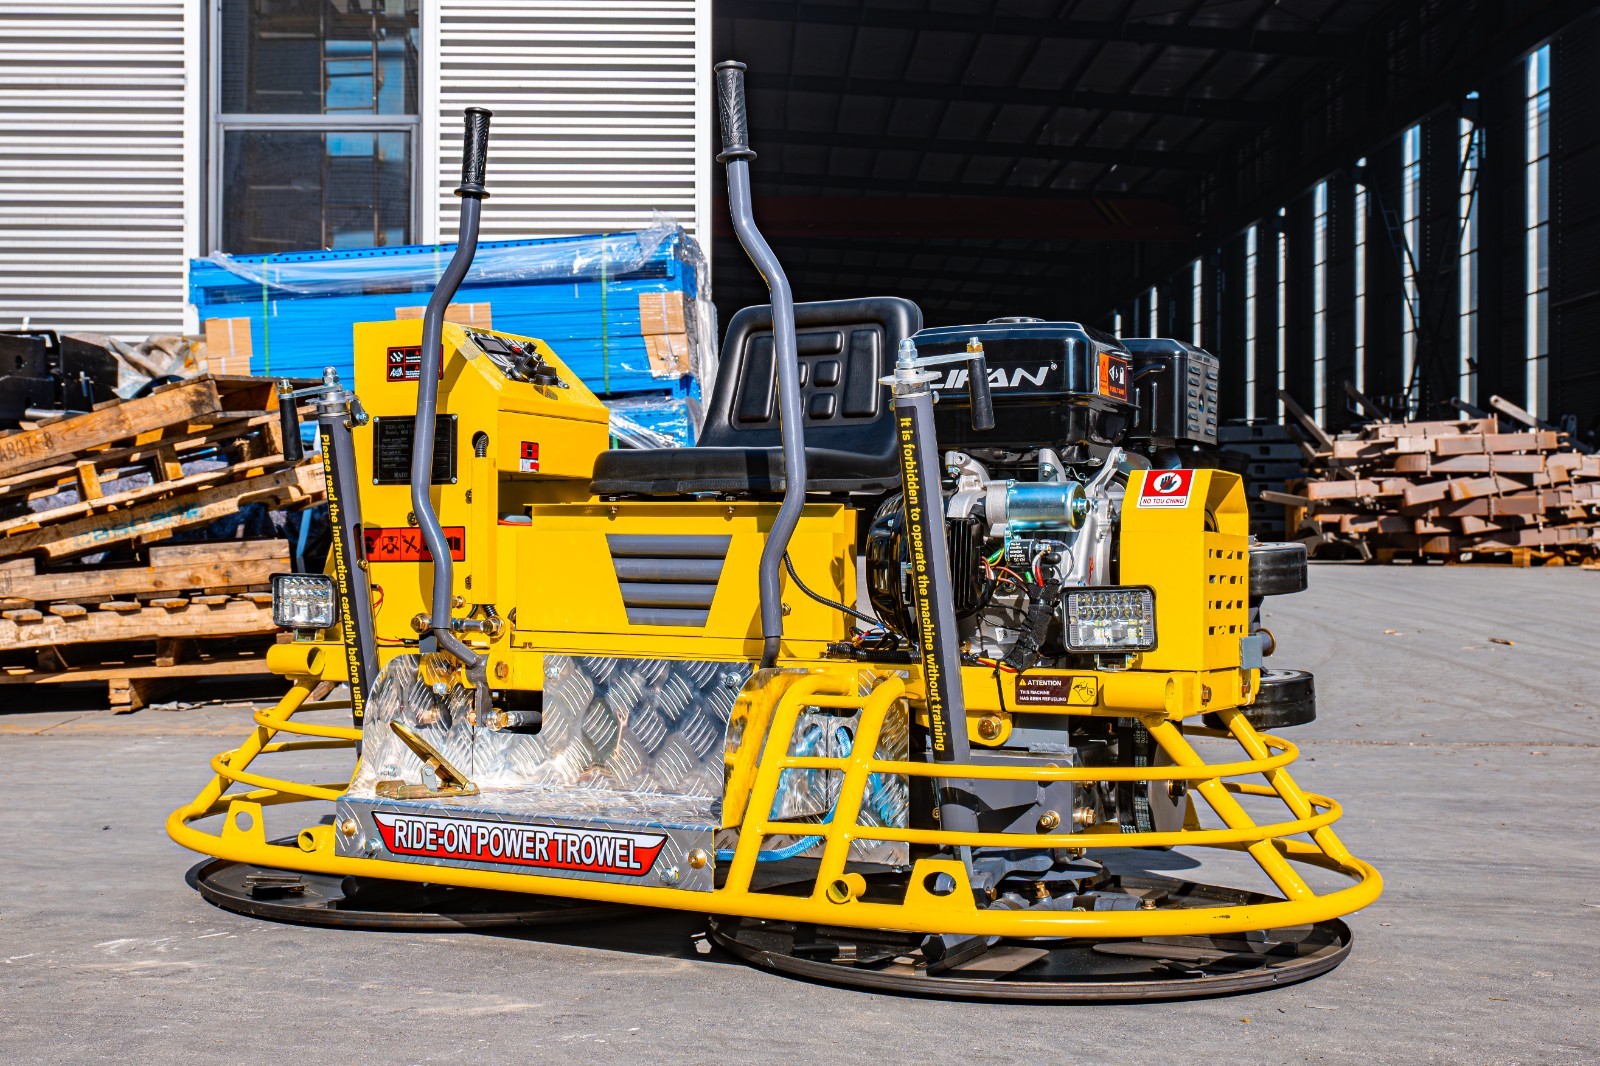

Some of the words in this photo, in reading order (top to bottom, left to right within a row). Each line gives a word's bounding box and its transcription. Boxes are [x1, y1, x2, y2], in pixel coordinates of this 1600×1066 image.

[900, 417, 912, 427] It
[902, 429, 914, 441] is
[320, 434, 331, 472] Please
[326, 474, 338, 501] read
[903, 443, 919, 505] forbidden
[330, 503, 340, 523] the
[910, 507, 921, 521] to
[333, 526, 348, 594] instructions
[911, 524, 927, 572] operate
[918, 574, 930, 596] the
[341, 596, 357, 645] carefully
[920, 598, 936, 651] machine
[348, 647, 360, 684] before
[926, 653, 940, 702] without
[353, 686, 365, 717] using
[932, 703, 947, 751] training
[394, 820, 471, 854] RIDE-ON
[477, 826, 549, 861] POWER
[554, 833, 641, 869] TROWEL
